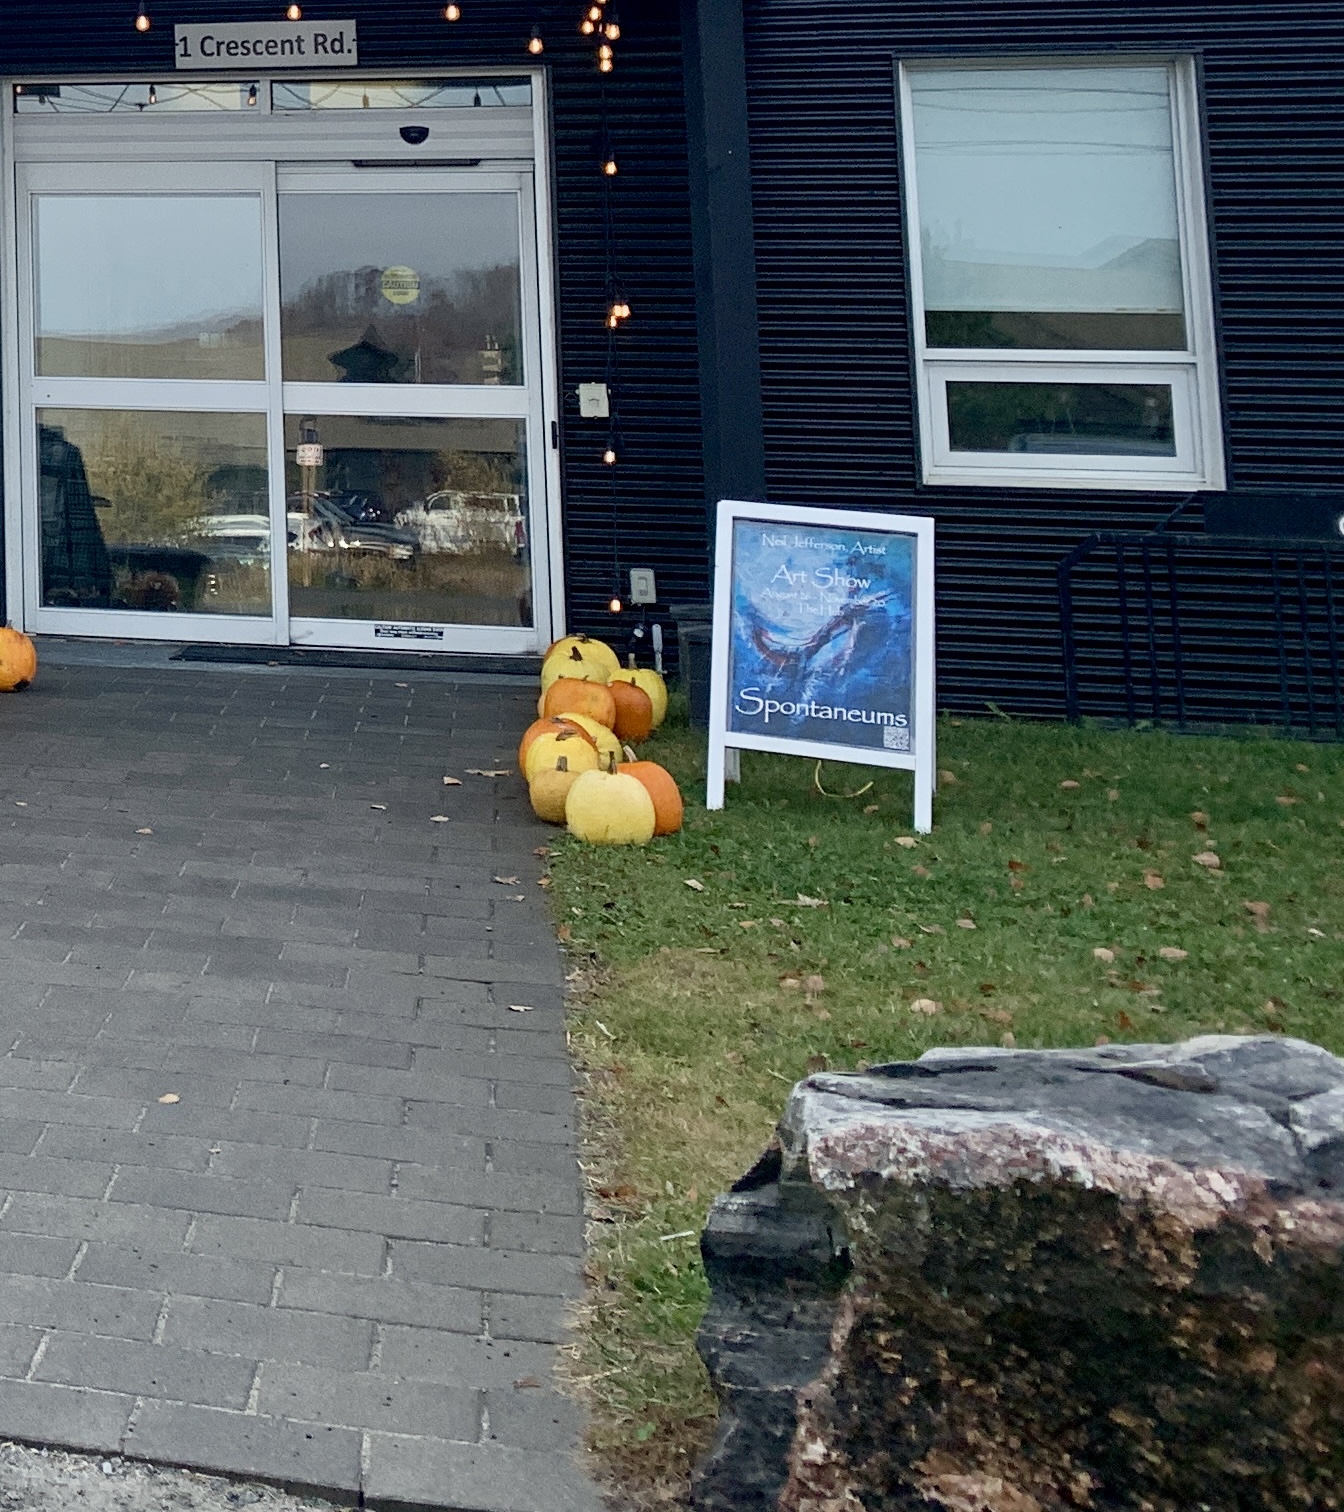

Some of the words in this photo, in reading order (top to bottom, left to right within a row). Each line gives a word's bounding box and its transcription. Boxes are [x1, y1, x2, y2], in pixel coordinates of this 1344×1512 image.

[179, 37, 192, 57] 1
[200, 35, 305, 57] Crescent
[314, 31, 352, 55] Rd.
[762, 533, 787, 547] Neil
[793, 536, 848, 553] Jefferson,
[850, 541, 887, 555] Artist
[771, 565, 808, 586] Art
[812, 567, 871, 589] Show
[798, 602, 819, 614] The
[819, 603, 845, 616] Hub
[735, 687, 908, 727] Spontaneums
